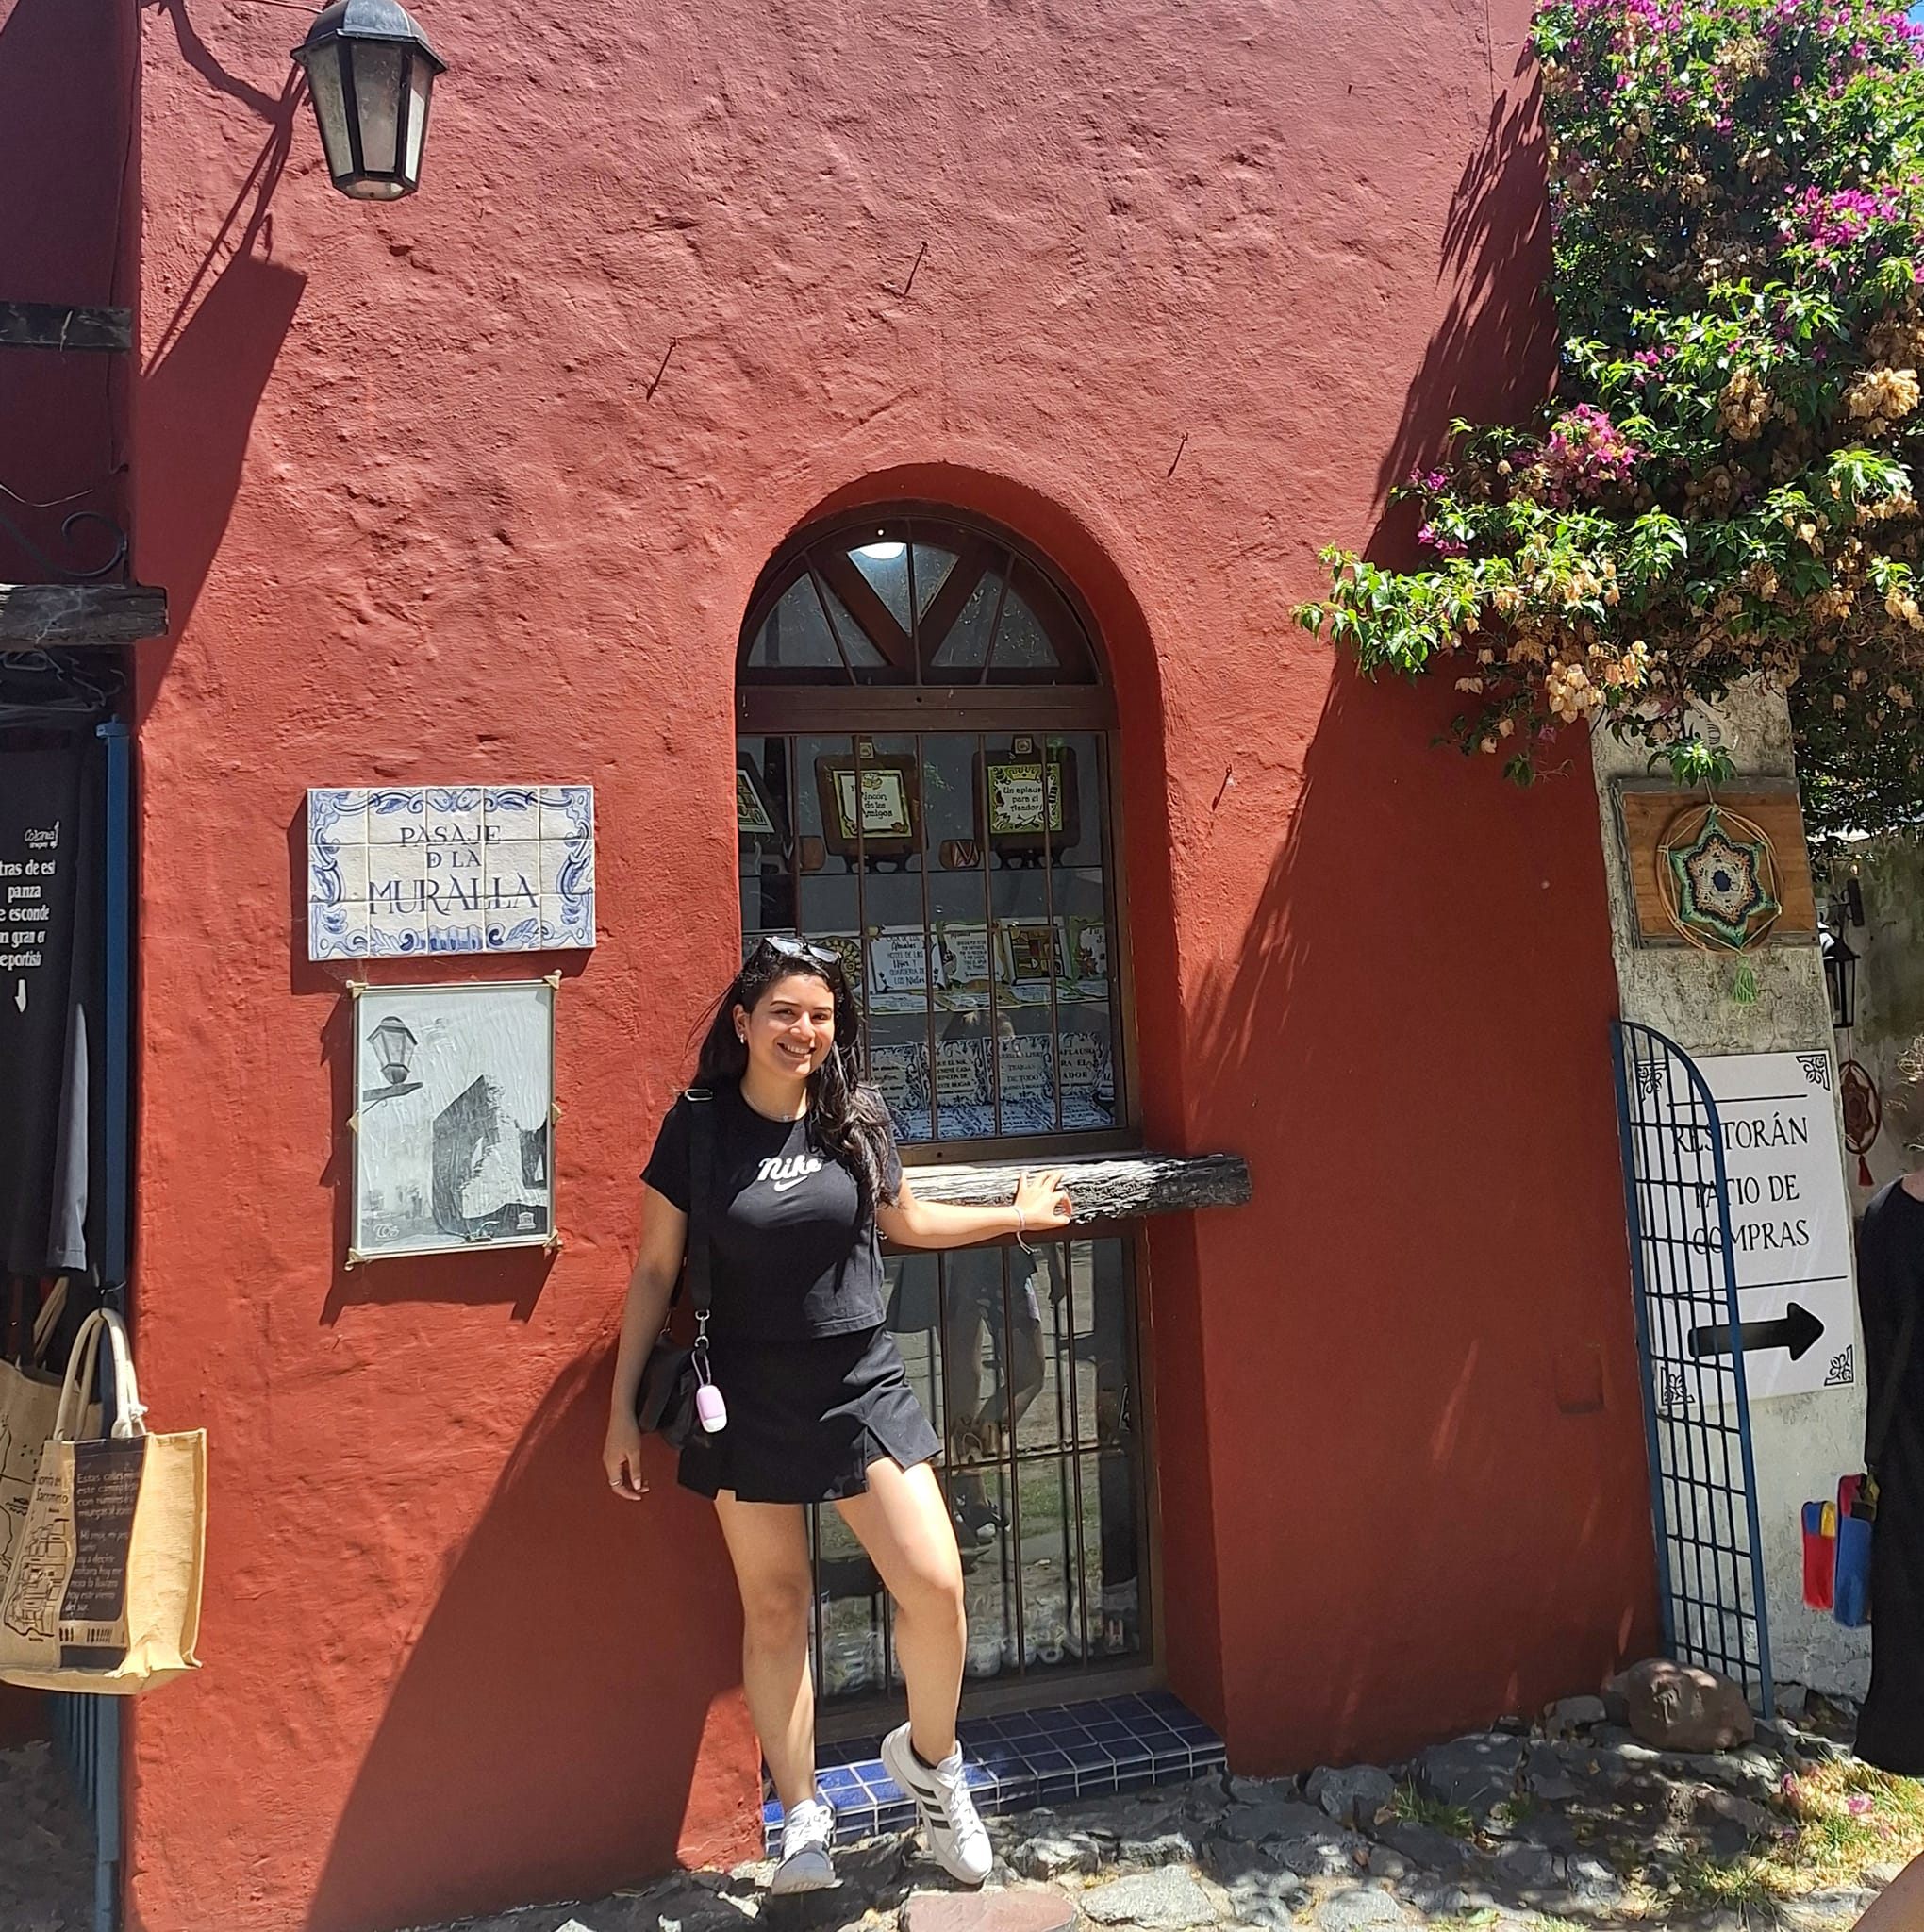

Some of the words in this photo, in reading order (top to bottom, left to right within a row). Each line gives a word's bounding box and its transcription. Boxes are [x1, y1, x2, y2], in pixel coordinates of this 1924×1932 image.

[399, 824, 502, 848] PASAJE
[25, 859, 40, 875] de
[452, 849, 482, 868] LA
[8, 886, 41, 903] panza
[369, 872, 539, 916] MURALLA
[11, 931, 36, 948] gran
[757, 1155, 822, 1181] Nike
[1768, 1174, 1800, 1202] DE
